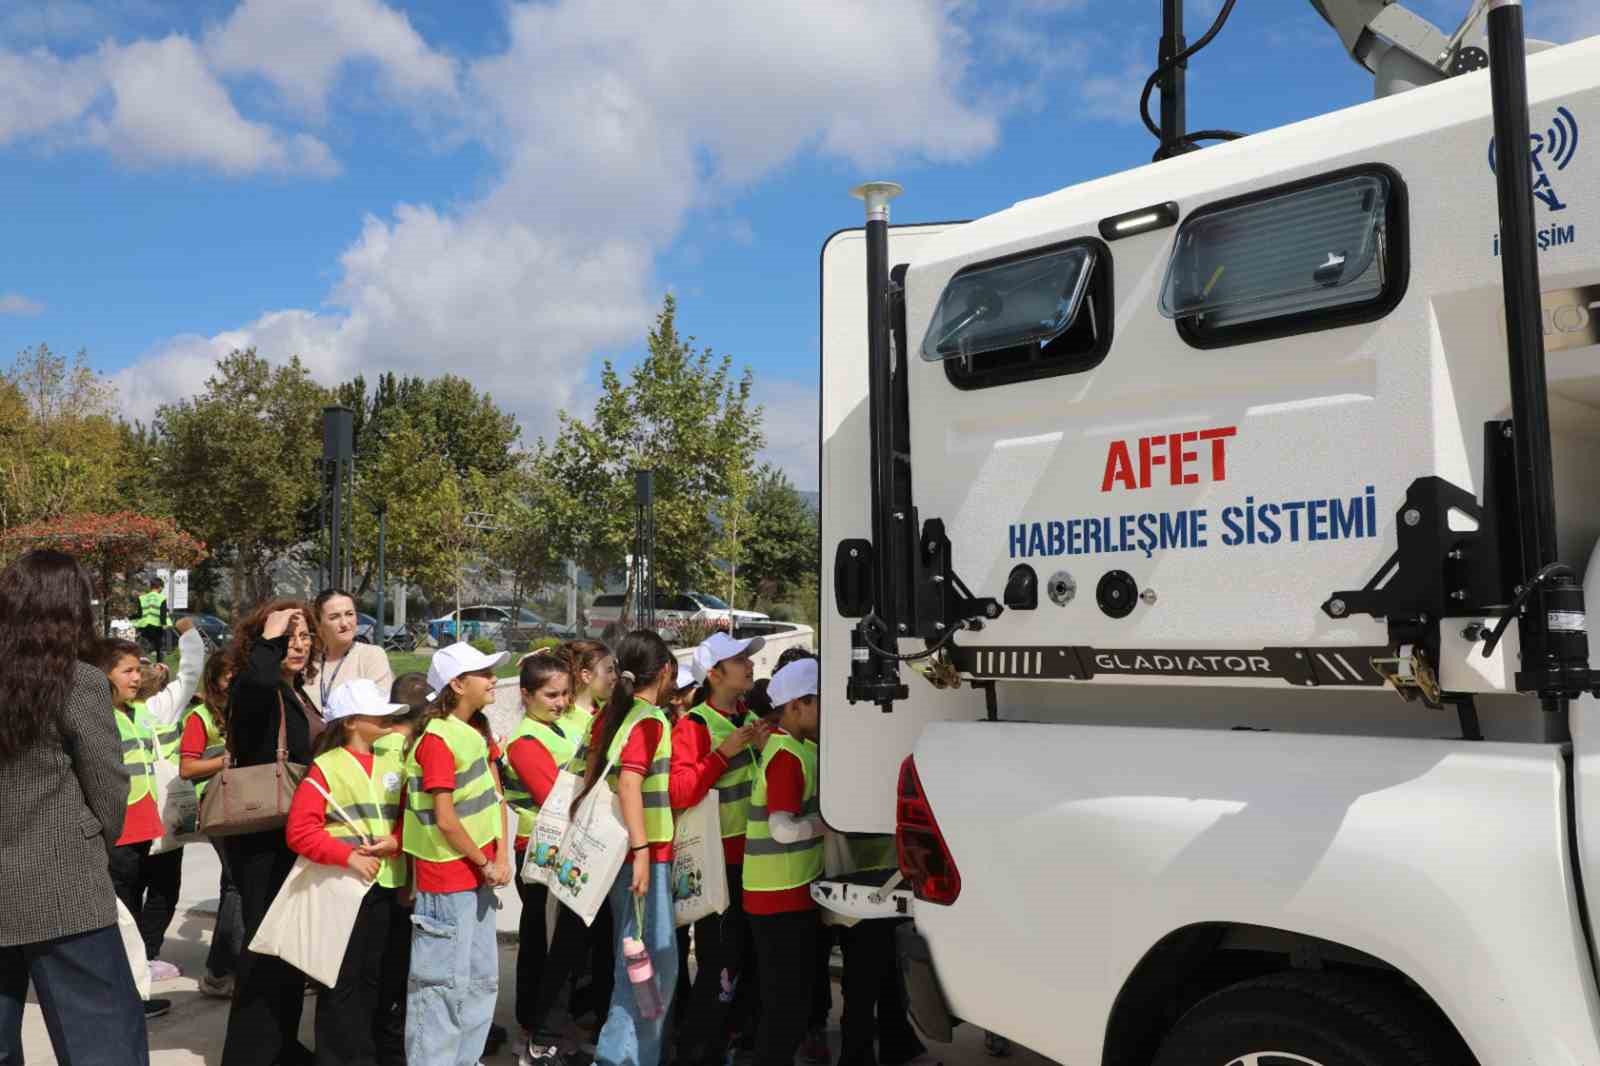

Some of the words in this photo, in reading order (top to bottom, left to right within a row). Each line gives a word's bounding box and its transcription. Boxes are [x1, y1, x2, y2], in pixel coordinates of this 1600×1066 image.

[1493, 223, 1575, 257] İŞİM
[1101, 425, 1237, 492] AFET
[1009, 509, 1208, 558] HABERLEŞME
[1221, 485, 1377, 546] SİSTEMİ
[1095, 654, 1273, 673] GLADIATOR
